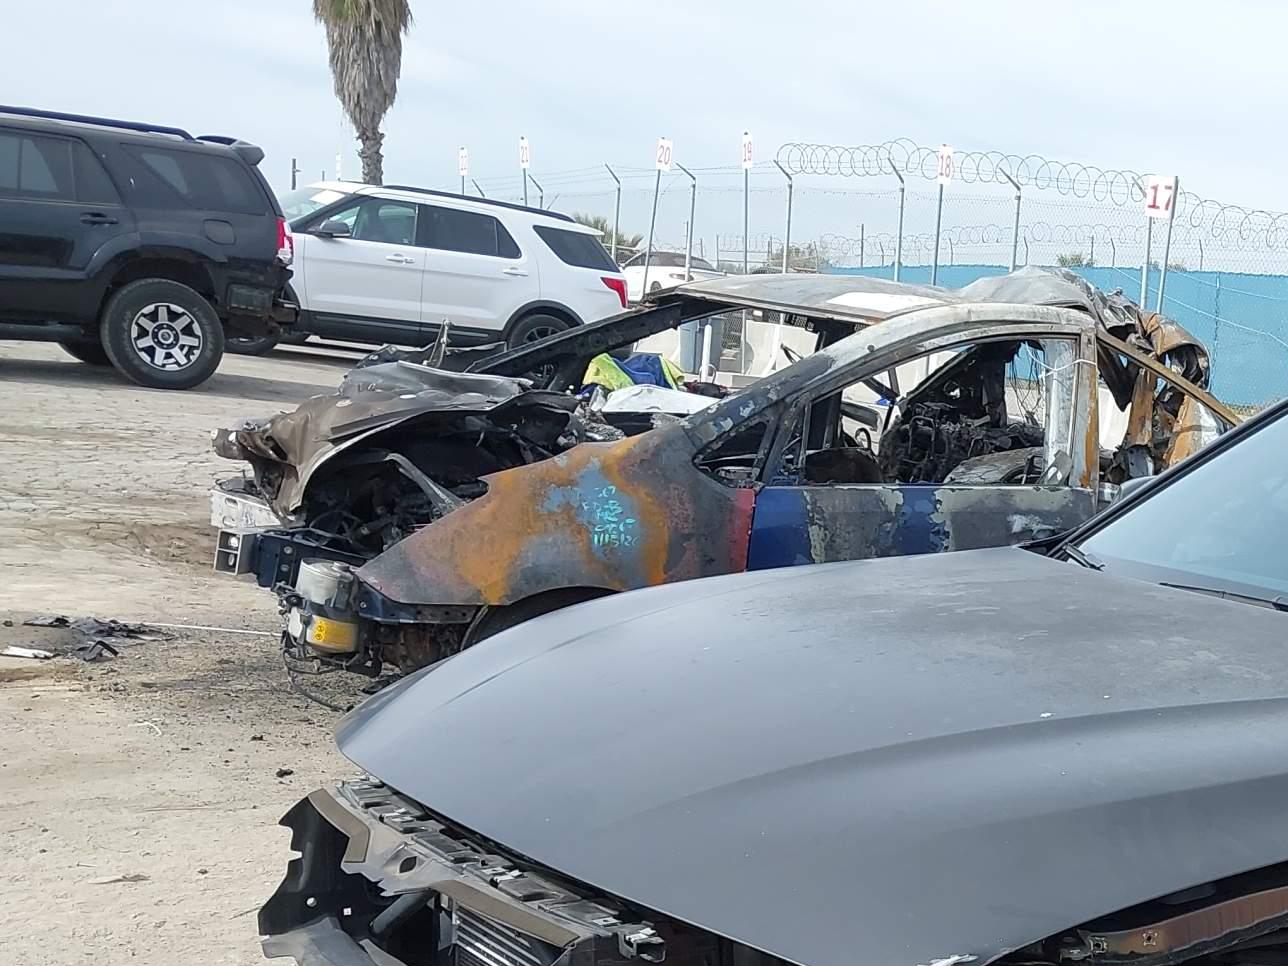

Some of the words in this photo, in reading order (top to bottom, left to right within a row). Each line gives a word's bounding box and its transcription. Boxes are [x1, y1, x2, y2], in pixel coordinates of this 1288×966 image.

[520, 145, 529, 163] 21
[656, 144, 671, 165] 20
[743, 141, 752, 163] 19
[938, 154, 951, 179] 18
[1147, 184, 1172, 211] 17
